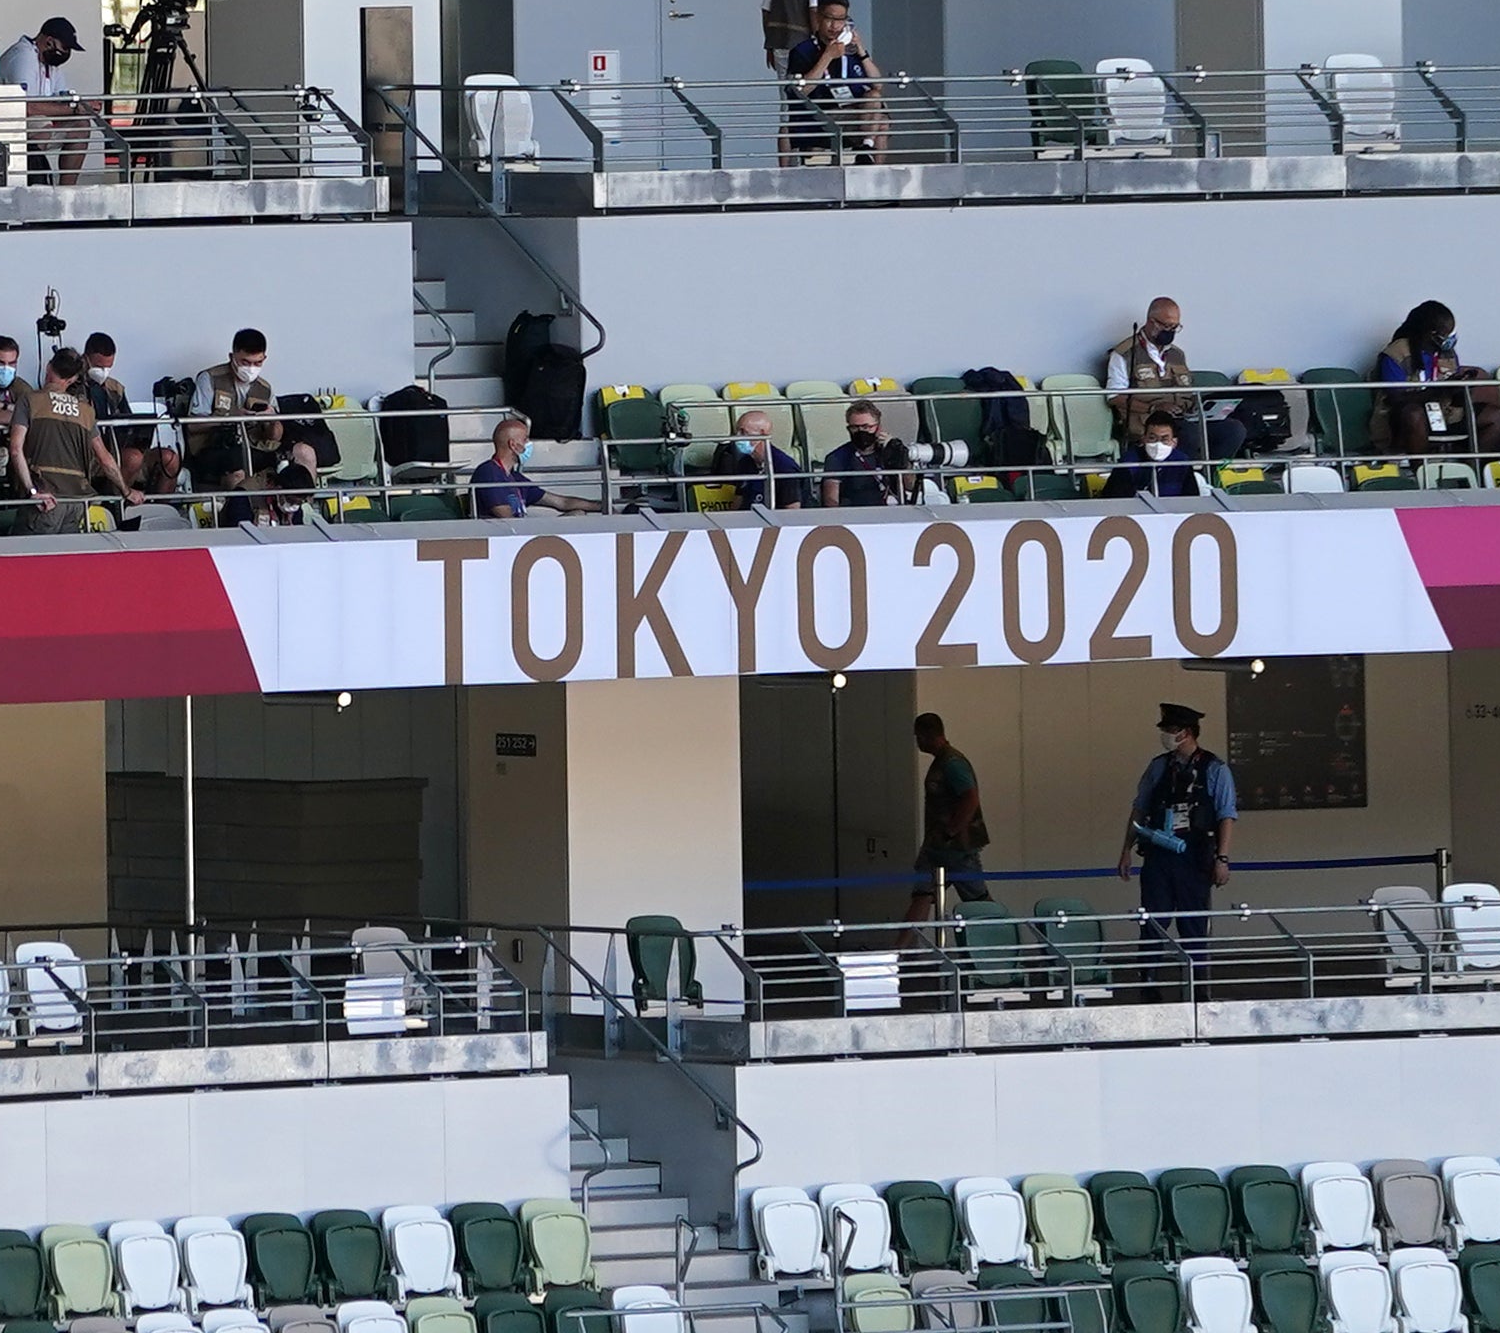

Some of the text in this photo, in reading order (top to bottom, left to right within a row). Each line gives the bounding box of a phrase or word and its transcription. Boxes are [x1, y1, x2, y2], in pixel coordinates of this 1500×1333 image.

[51, 399, 80, 417] 2035
[415, 513, 1240, 685] TOKYO 2020
